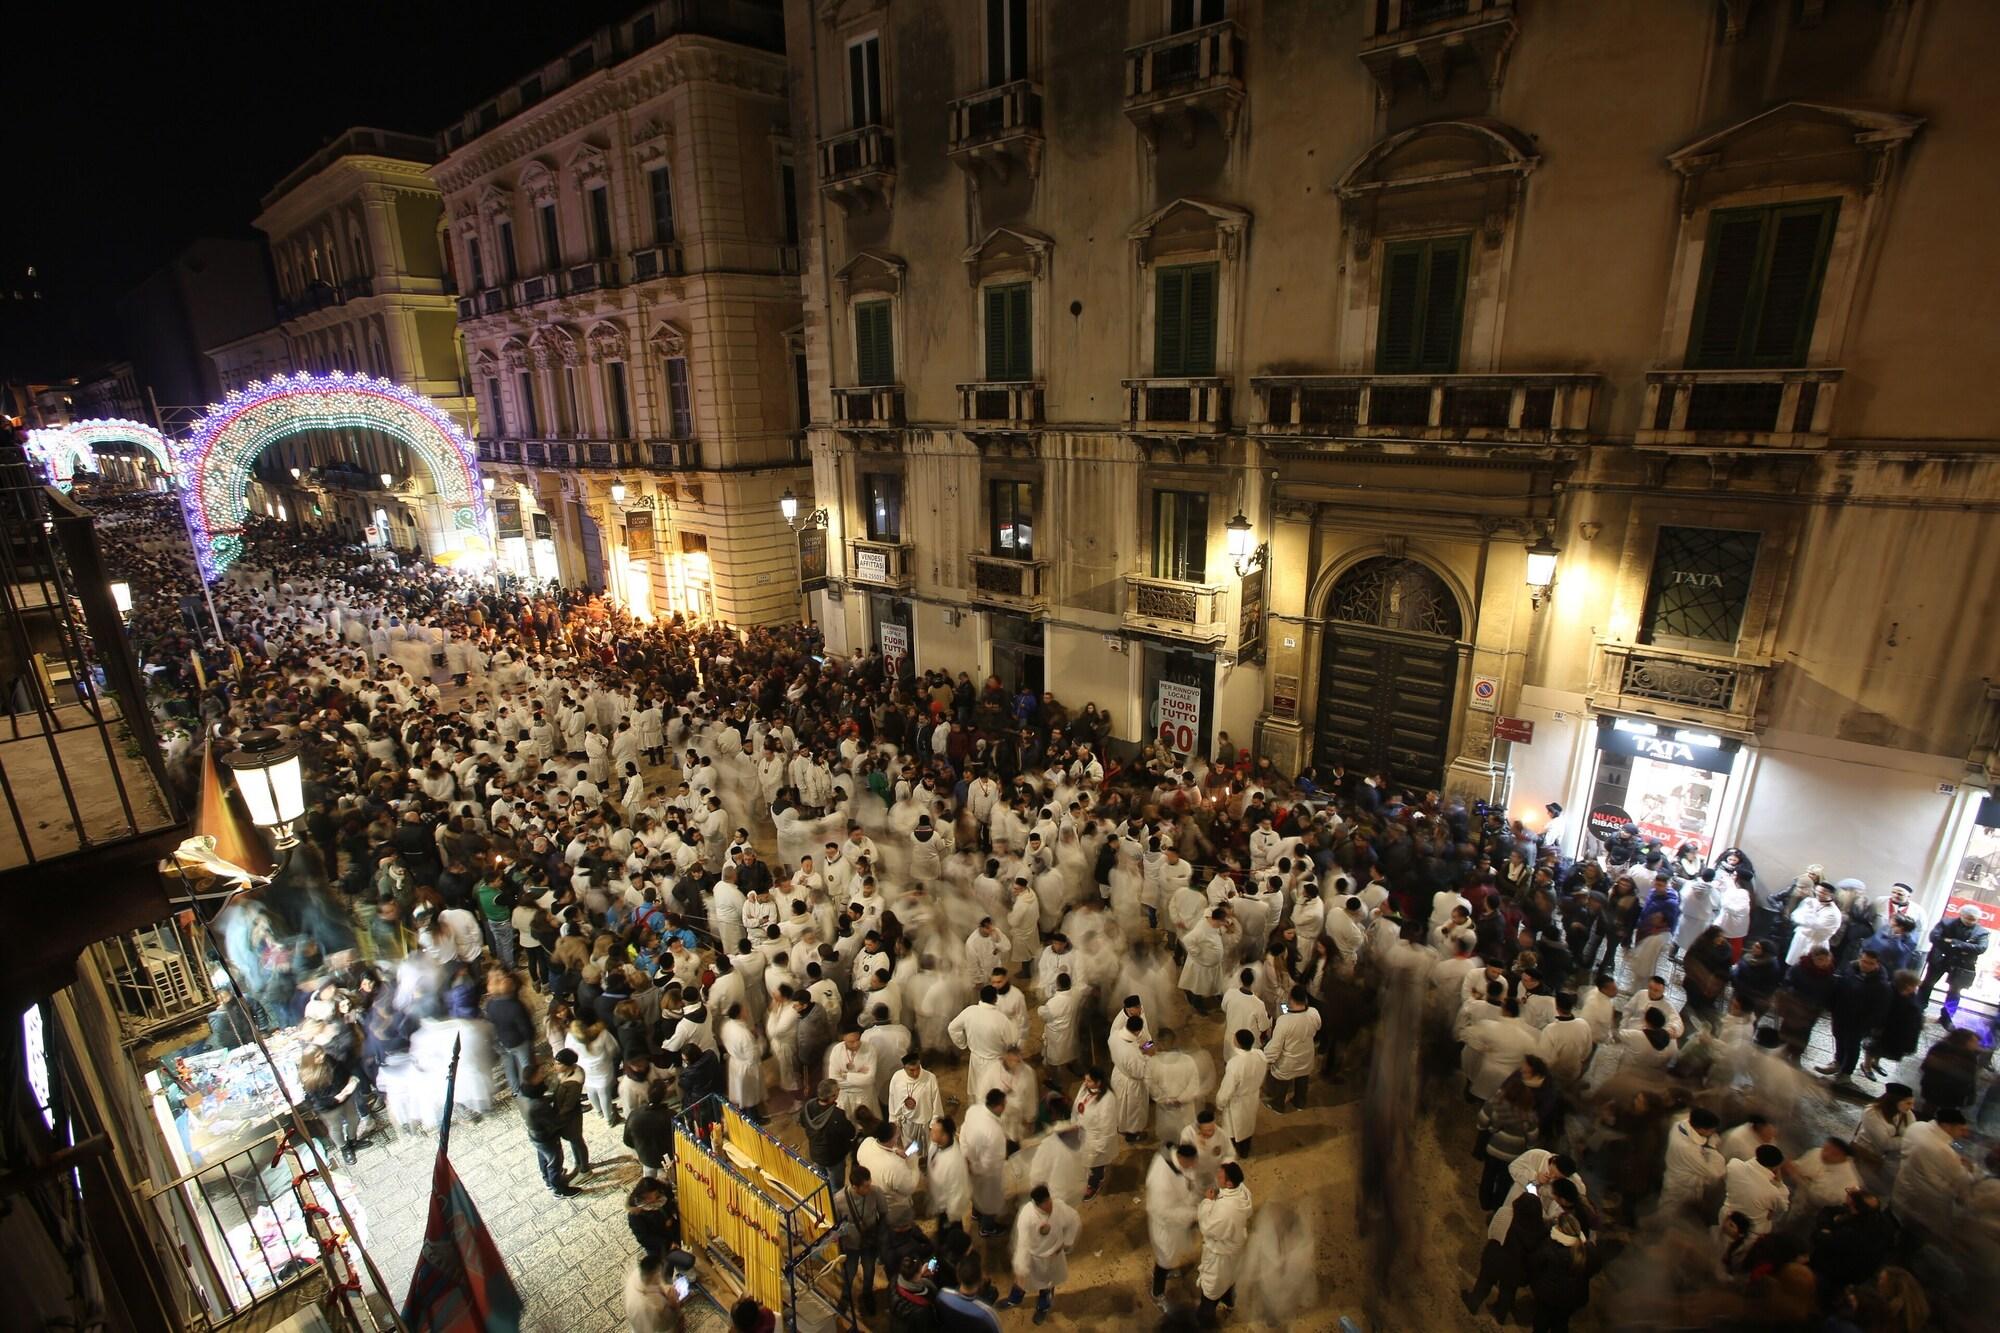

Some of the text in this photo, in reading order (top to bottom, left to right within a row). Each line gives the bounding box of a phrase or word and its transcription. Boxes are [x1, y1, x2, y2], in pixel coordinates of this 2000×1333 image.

[861, 554, 883, 562] VENDESI
[860, 560, 885, 569] AFFITTASI
[1671, 570, 1724, 588] TATA
[884, 636, 905, 646] FUORI
[1168, 691, 1192, 700] LOCALE
[1173, 686, 1200, 697] RINNOVO
[1163, 697, 1196, 713] FUORI
[1160, 707, 1198, 723] TUTTO
[1632, 734, 1695, 761] TATA
[1593, 812, 1632, 824] NUOVI
[1637, 827, 1671, 842] SALDI
